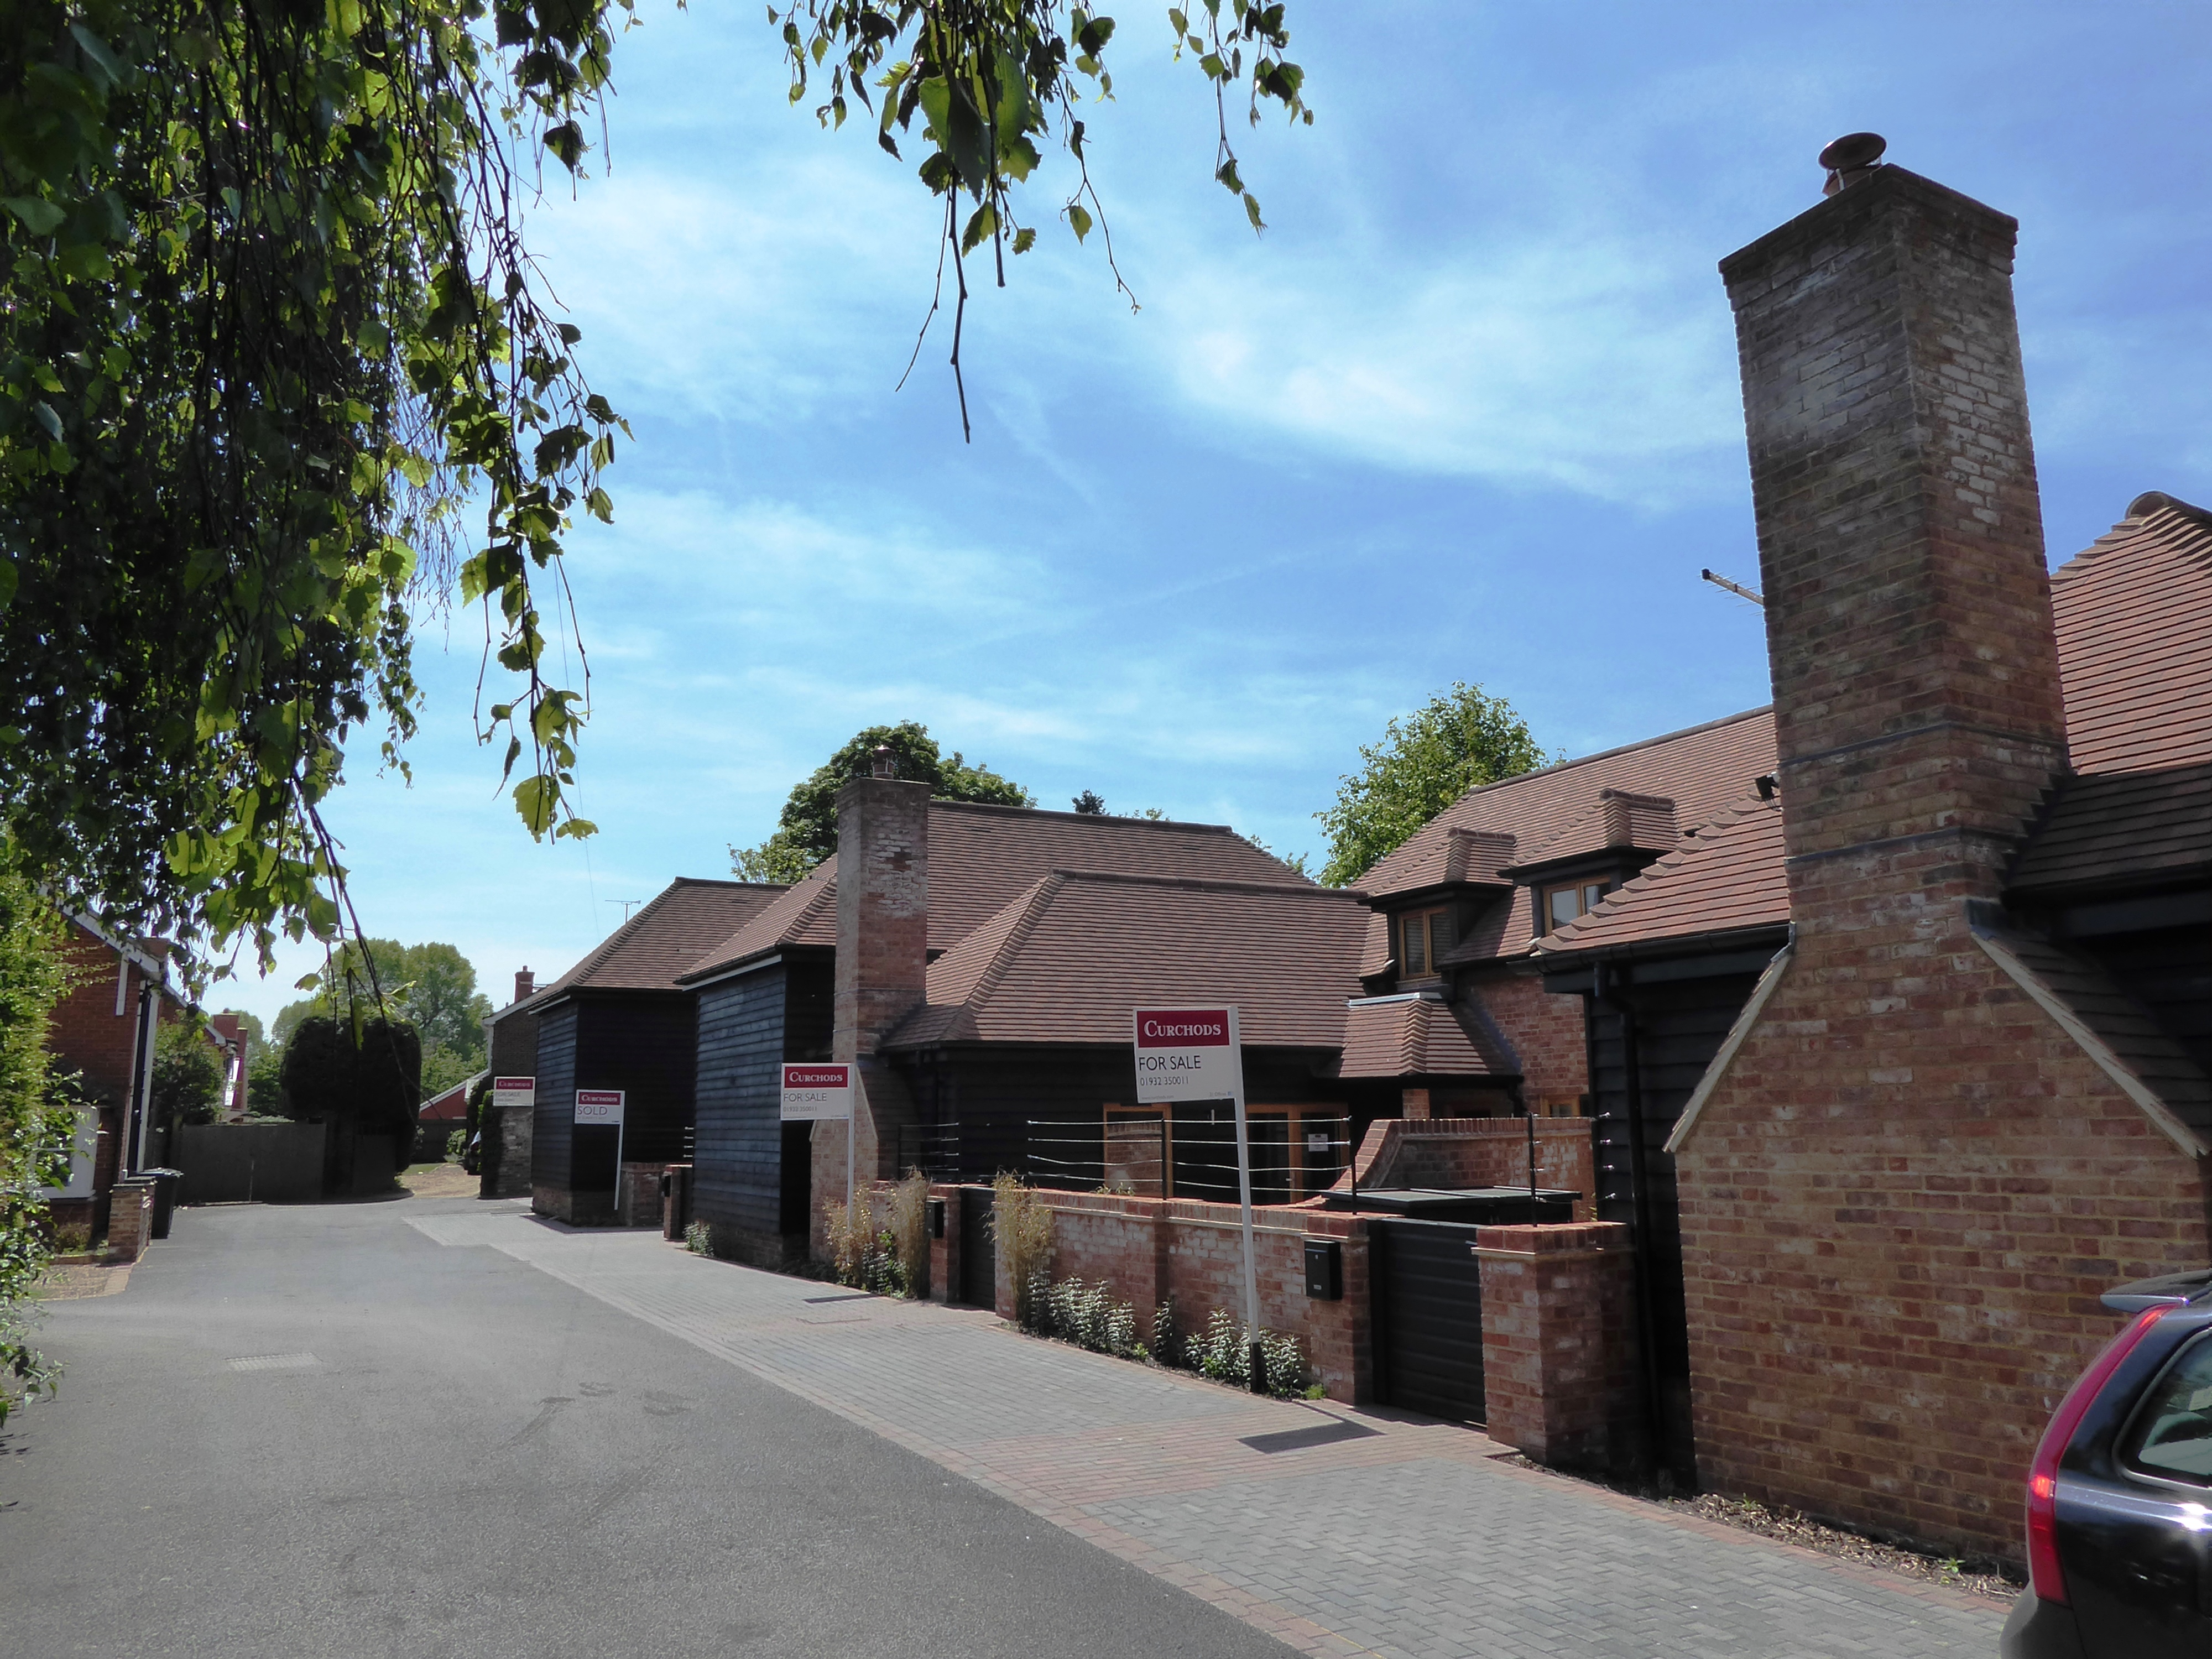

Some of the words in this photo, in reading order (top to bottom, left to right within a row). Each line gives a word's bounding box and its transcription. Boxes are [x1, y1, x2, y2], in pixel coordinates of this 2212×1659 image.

[1144, 1020, 1222, 1037] CURCHODS
[1139, 1056, 1167, 1071] FOR
[1170, 1055, 1202, 1070] SALE
[789, 1071, 843, 1082] CURCHODS
[1140, 1077, 1162, 1086] 01932
[1164, 1076, 1189, 1085] 350011
[783, 1093, 803, 1102] FOR
[805, 1092, 827, 1102] SALE
[577, 1106, 608, 1115] SOLD
